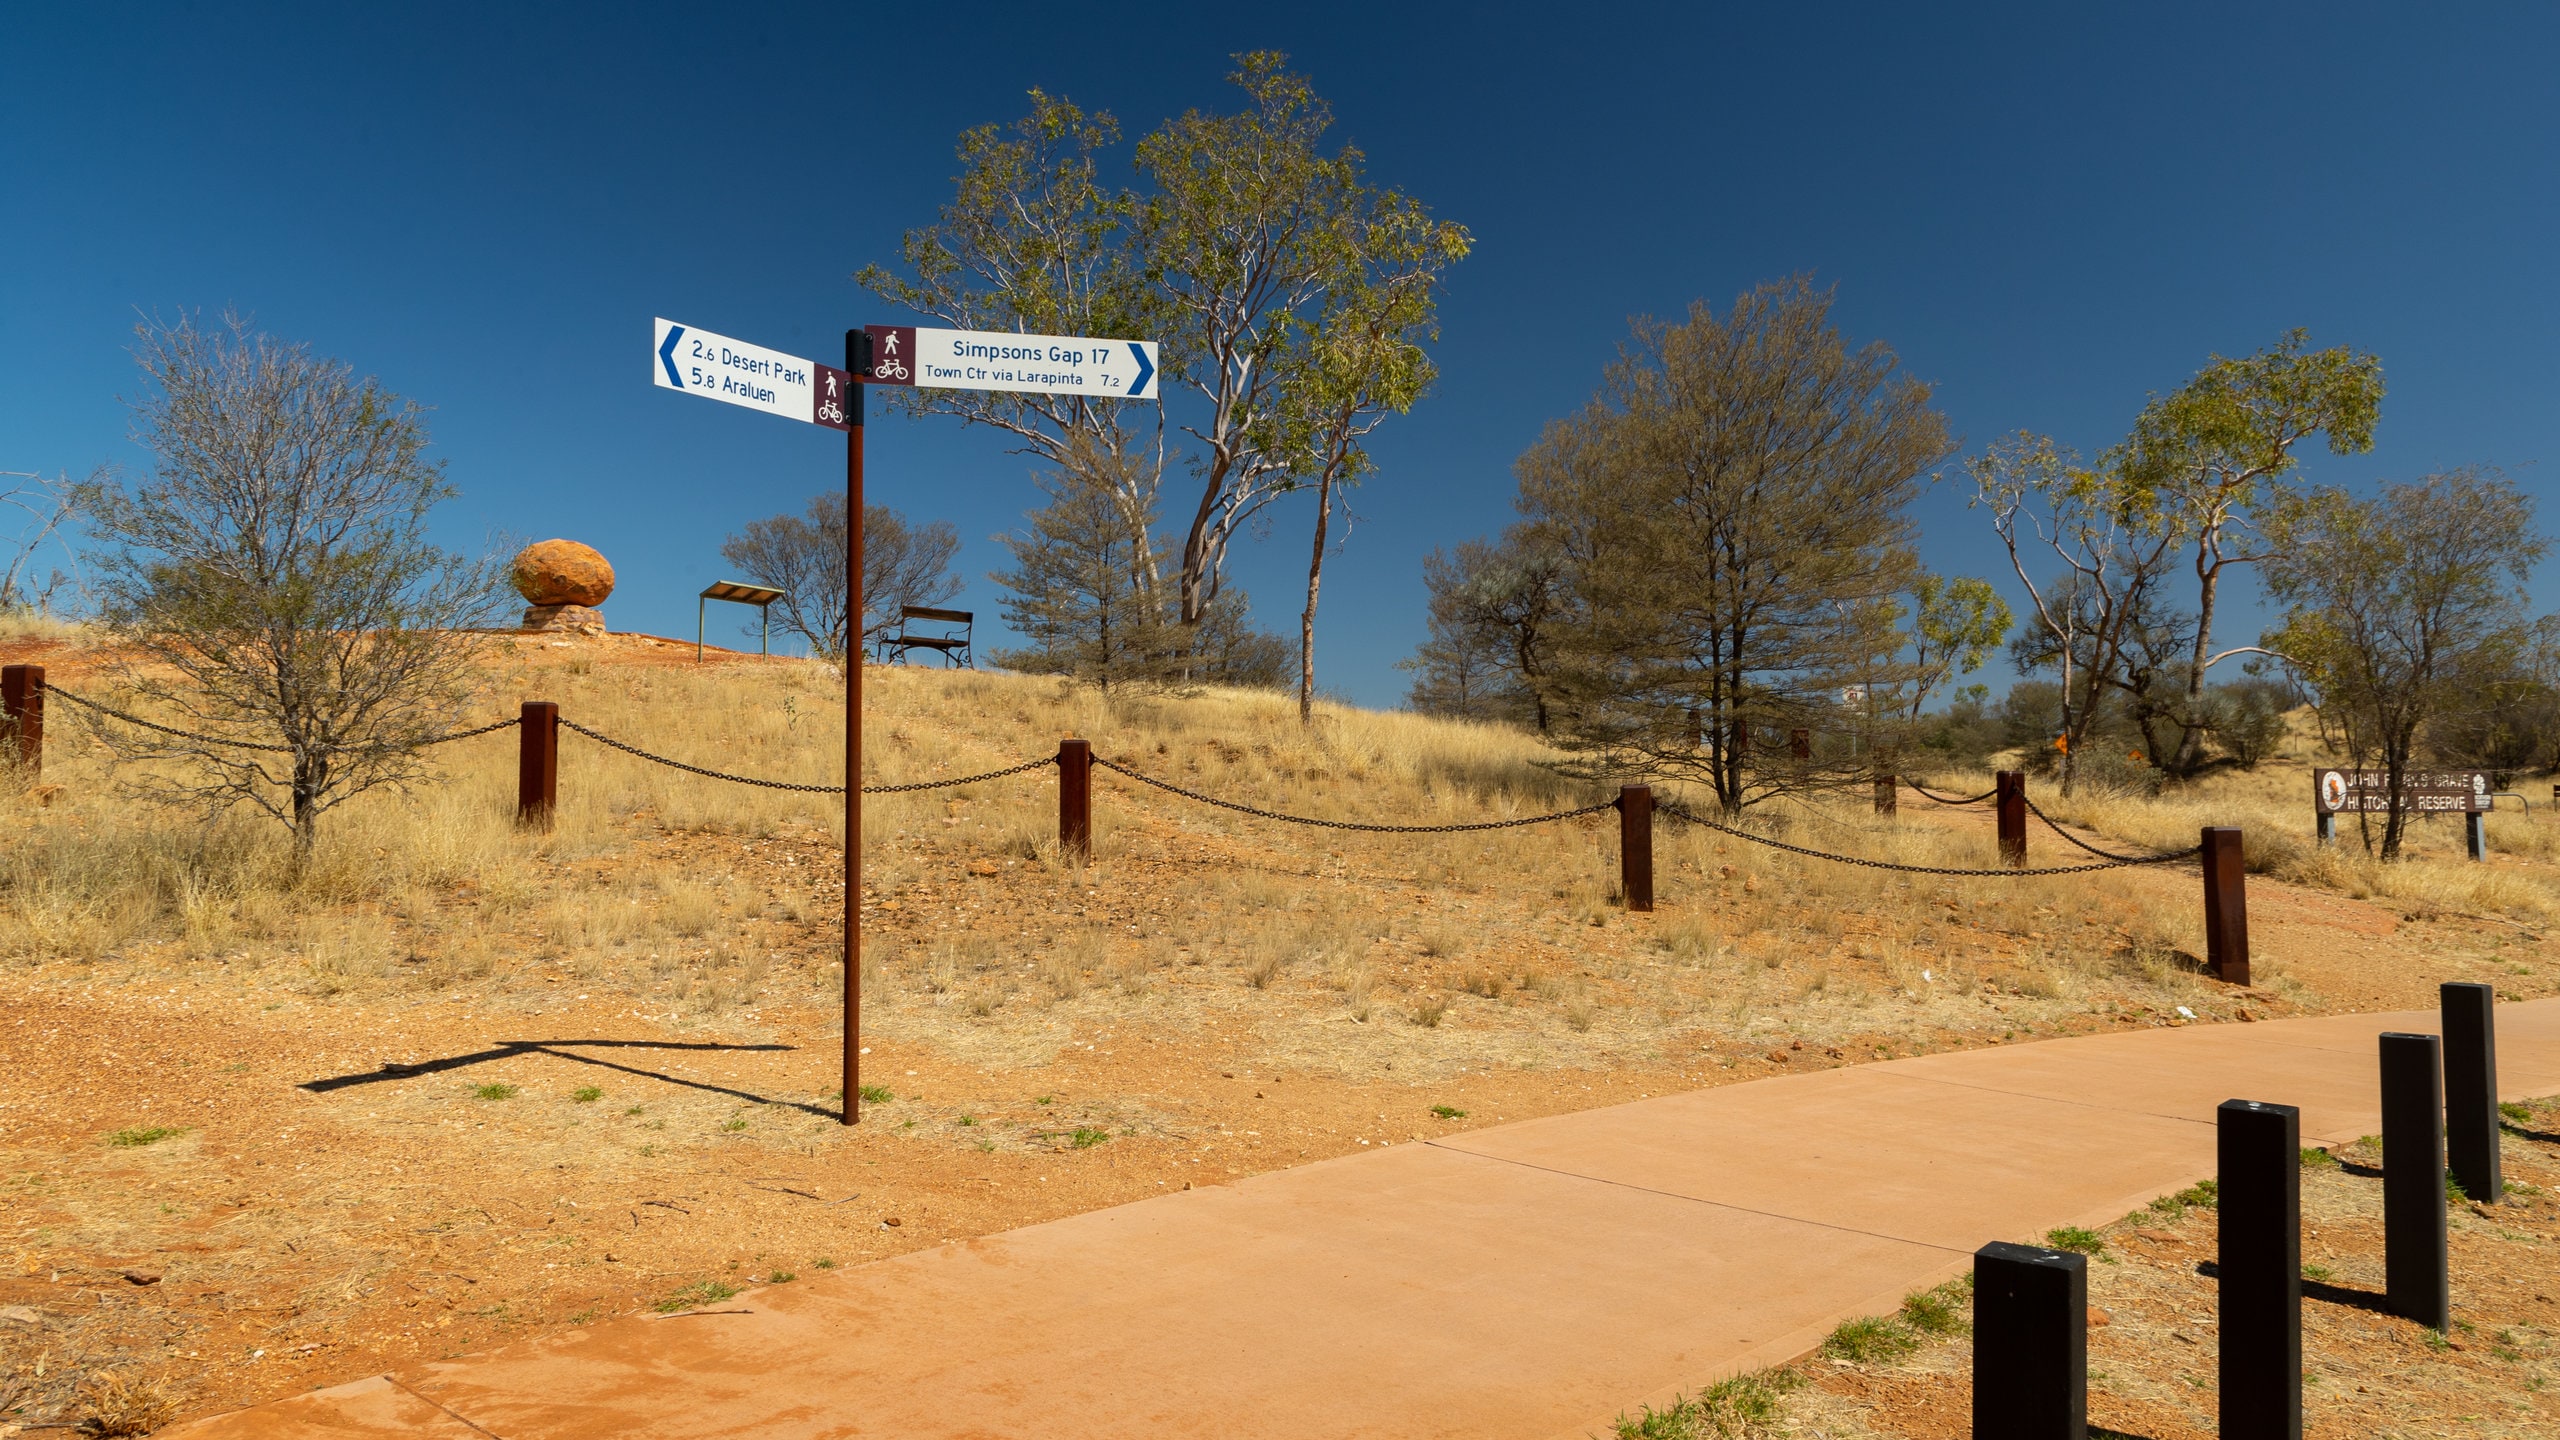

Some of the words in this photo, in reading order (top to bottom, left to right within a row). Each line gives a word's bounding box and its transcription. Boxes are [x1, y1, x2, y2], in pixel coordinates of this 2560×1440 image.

[692, 339, 715, 361] 2.6
[722, 347, 770, 377] Desert
[775, 362, 806, 387] Park
[953, 340, 1042, 362] Simpsons
[1049, 346, 1083, 366] Gap
[1092, 348, 1110, 365] 17
[691, 367, 715, 389] 5.8
[722, 375, 775, 404] Araluen
[925, 364, 962, 379] Town
[967, 367, 987, 381] Ctr
[992, 368, 1013, 382] via
[1017, 370, 1083, 387] Larapinta
[1101, 374, 1120, 388] 7.2
[2347, 773, 2379, 787] JOHN
[2418, 796, 2466, 810] RESERVE
